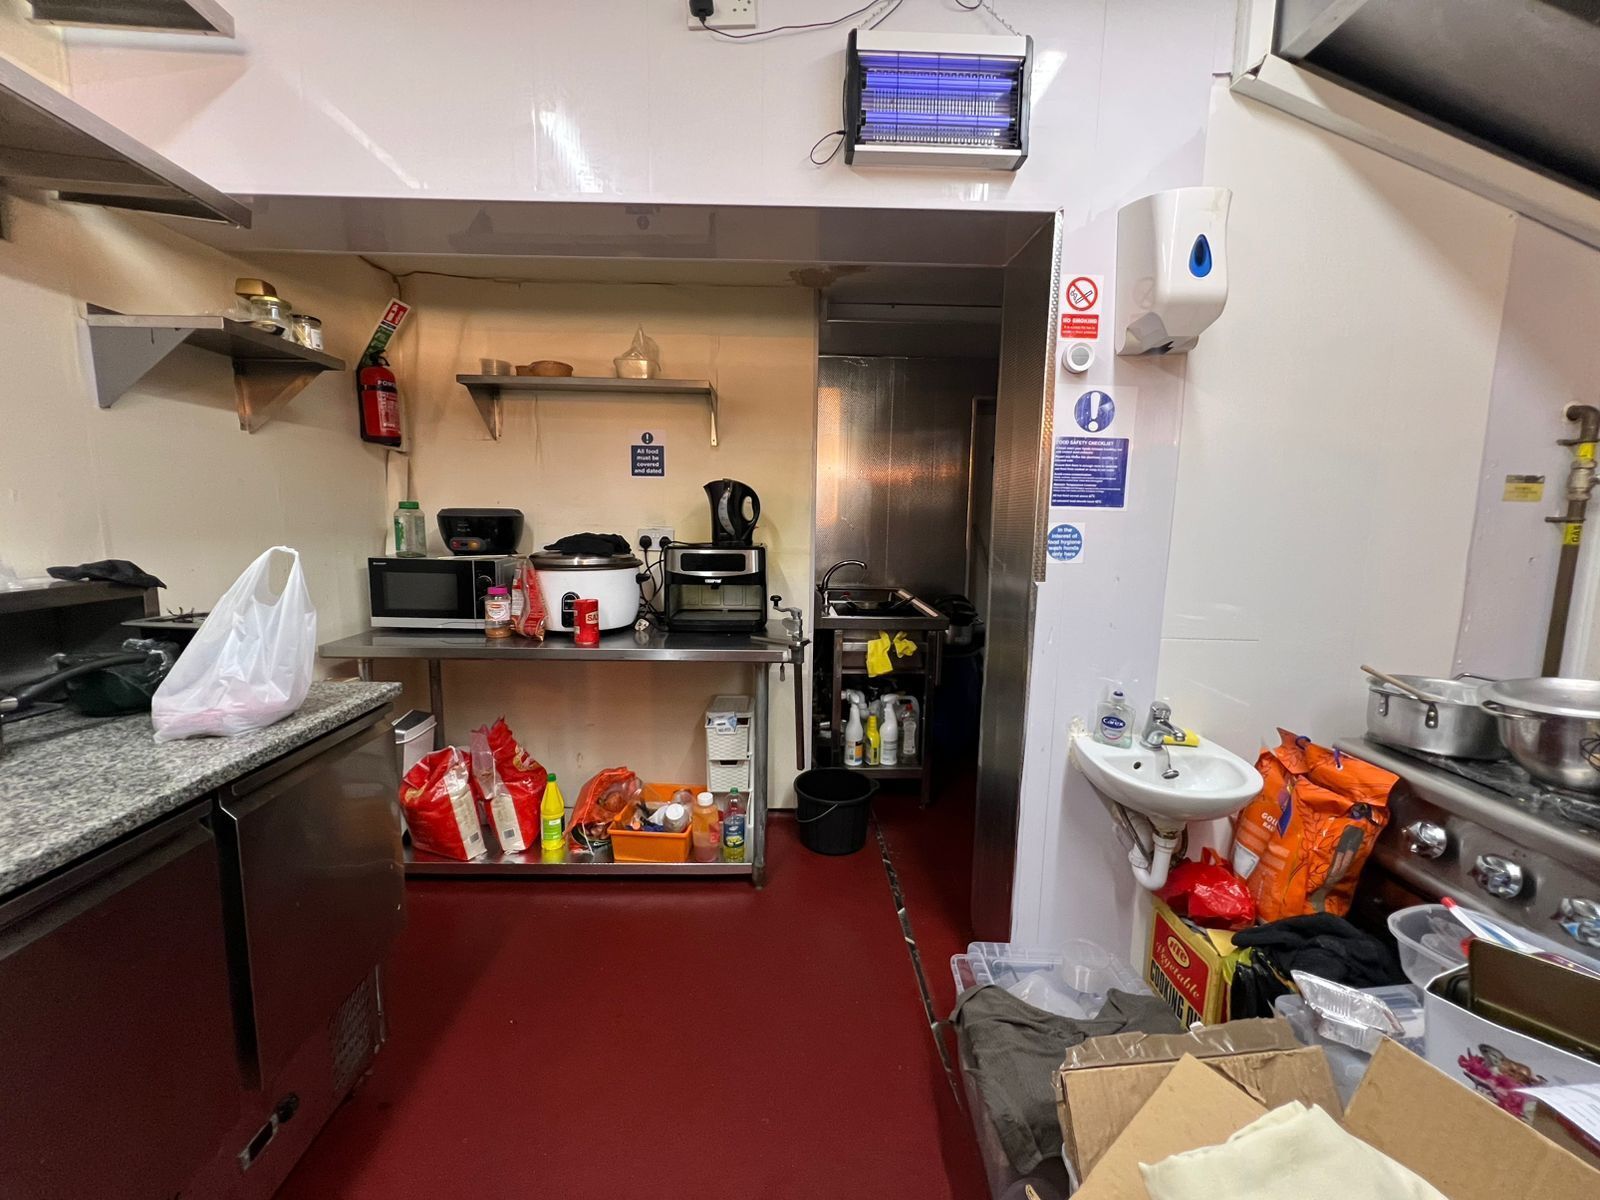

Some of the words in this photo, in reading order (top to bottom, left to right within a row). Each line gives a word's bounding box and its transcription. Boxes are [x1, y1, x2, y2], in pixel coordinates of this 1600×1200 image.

[1103, 718, 1124, 727] Carex
[1151, 959, 1184, 1020] COOKING
[1156, 942, 1200, 998] Vegetable
